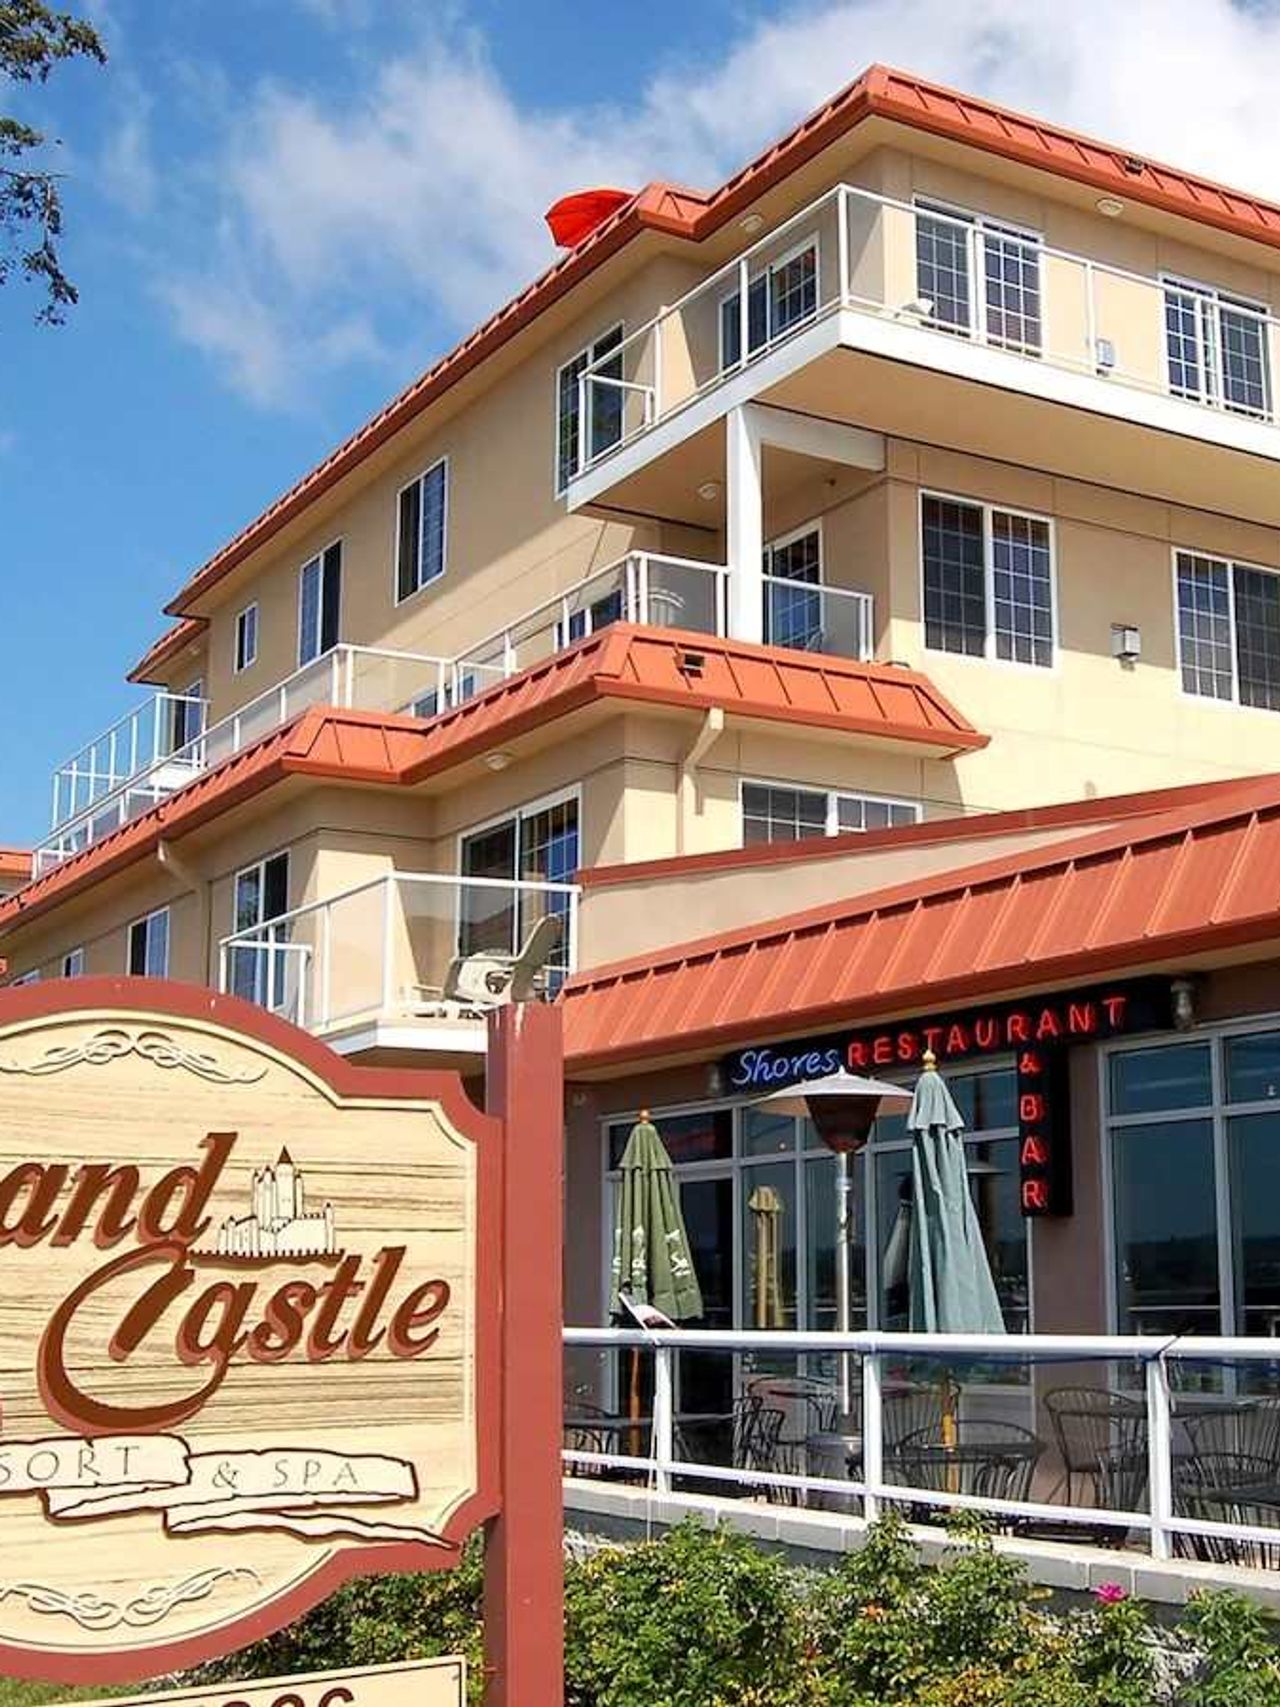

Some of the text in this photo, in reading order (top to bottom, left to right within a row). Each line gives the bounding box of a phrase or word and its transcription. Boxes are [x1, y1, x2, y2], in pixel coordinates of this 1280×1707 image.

[731, 997, 1127, 1086] Shores RESTAURANT
[1019, 1052, 1048, 1209] & BAR
[36, 1239, 451, 1436] Castle
[211, 1460, 238, 1490] &
[272, 1458, 358, 1488] SPA
